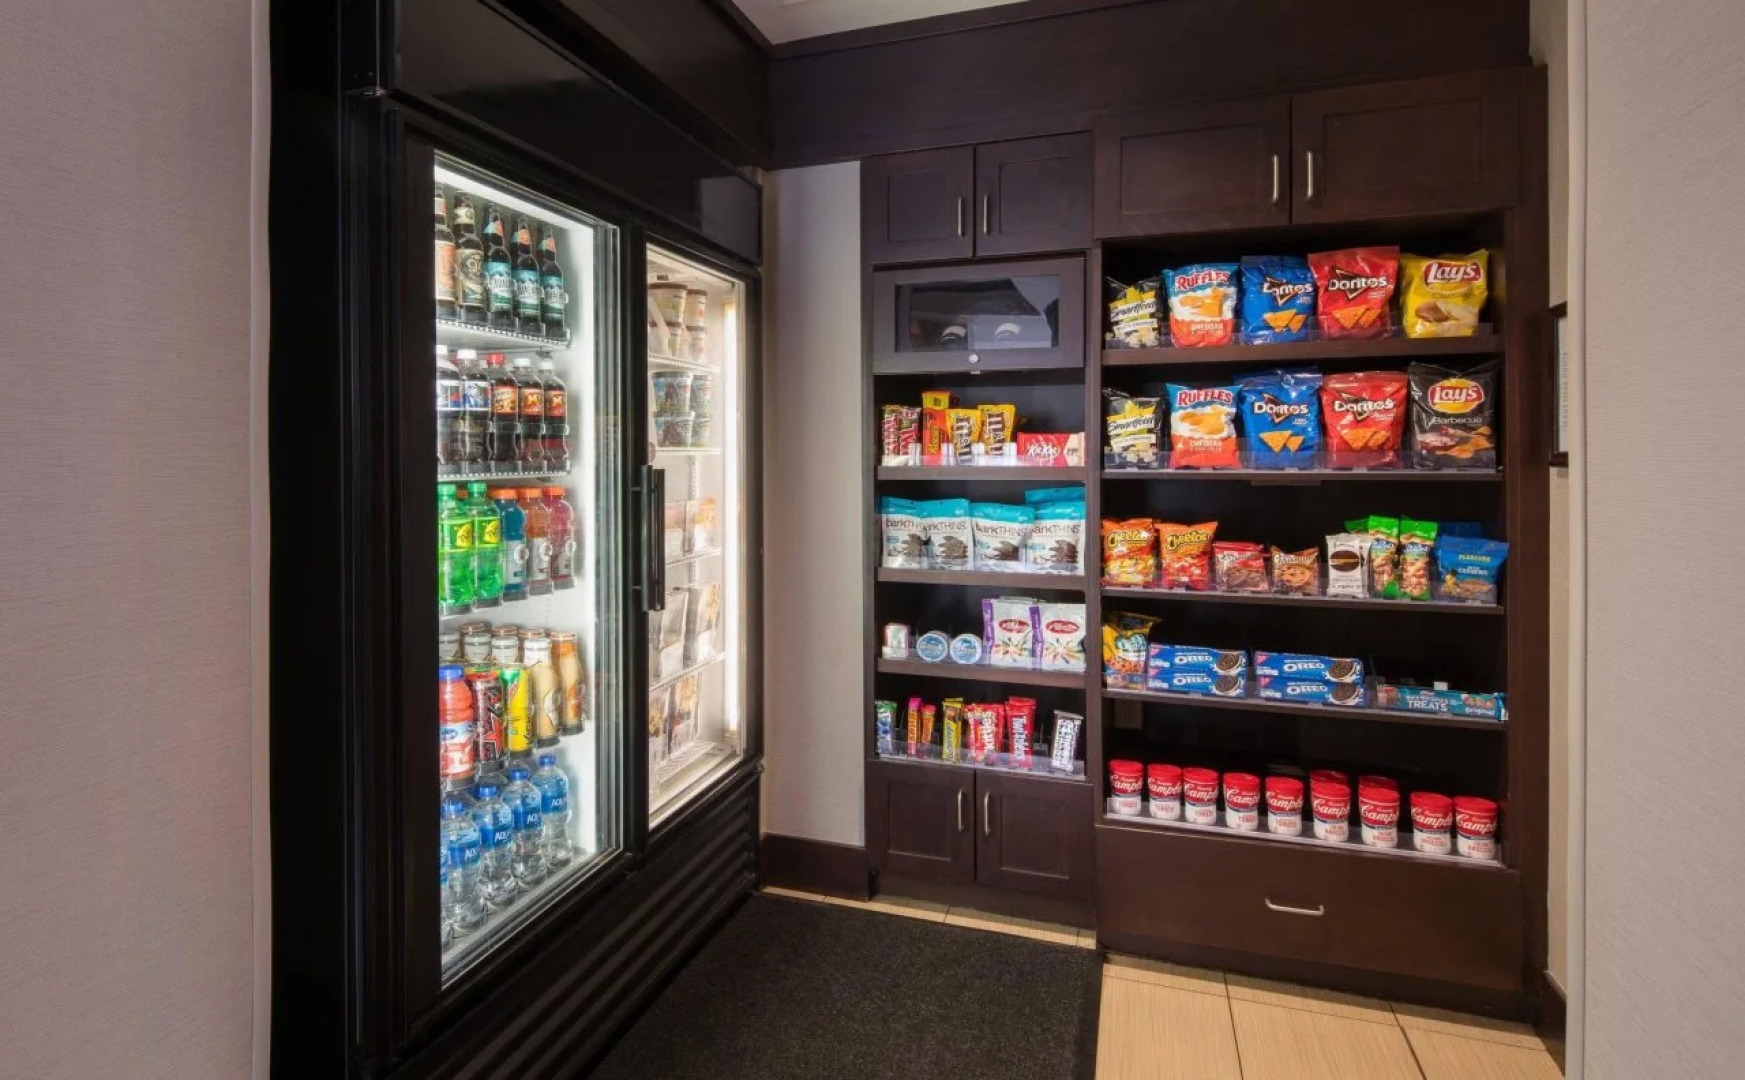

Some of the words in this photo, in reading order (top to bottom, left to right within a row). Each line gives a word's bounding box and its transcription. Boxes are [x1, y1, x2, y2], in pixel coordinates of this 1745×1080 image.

[1175, 270, 1231, 291] RUFFLES
[1328, 276, 1388, 291] Doritos
[1177, 389, 1233, 406] RUFFLES
[1253, 401, 1309, 415] Doritos
[1334, 399, 1396, 413] Doritos
[1174, 655, 1214, 665] OREO
[1283, 662, 1325, 672] OREO
[1173, 677, 1212, 686] OREO
[1286, 685, 1329, 695] OREO
[1408, 700, 1448, 712] TREATS
